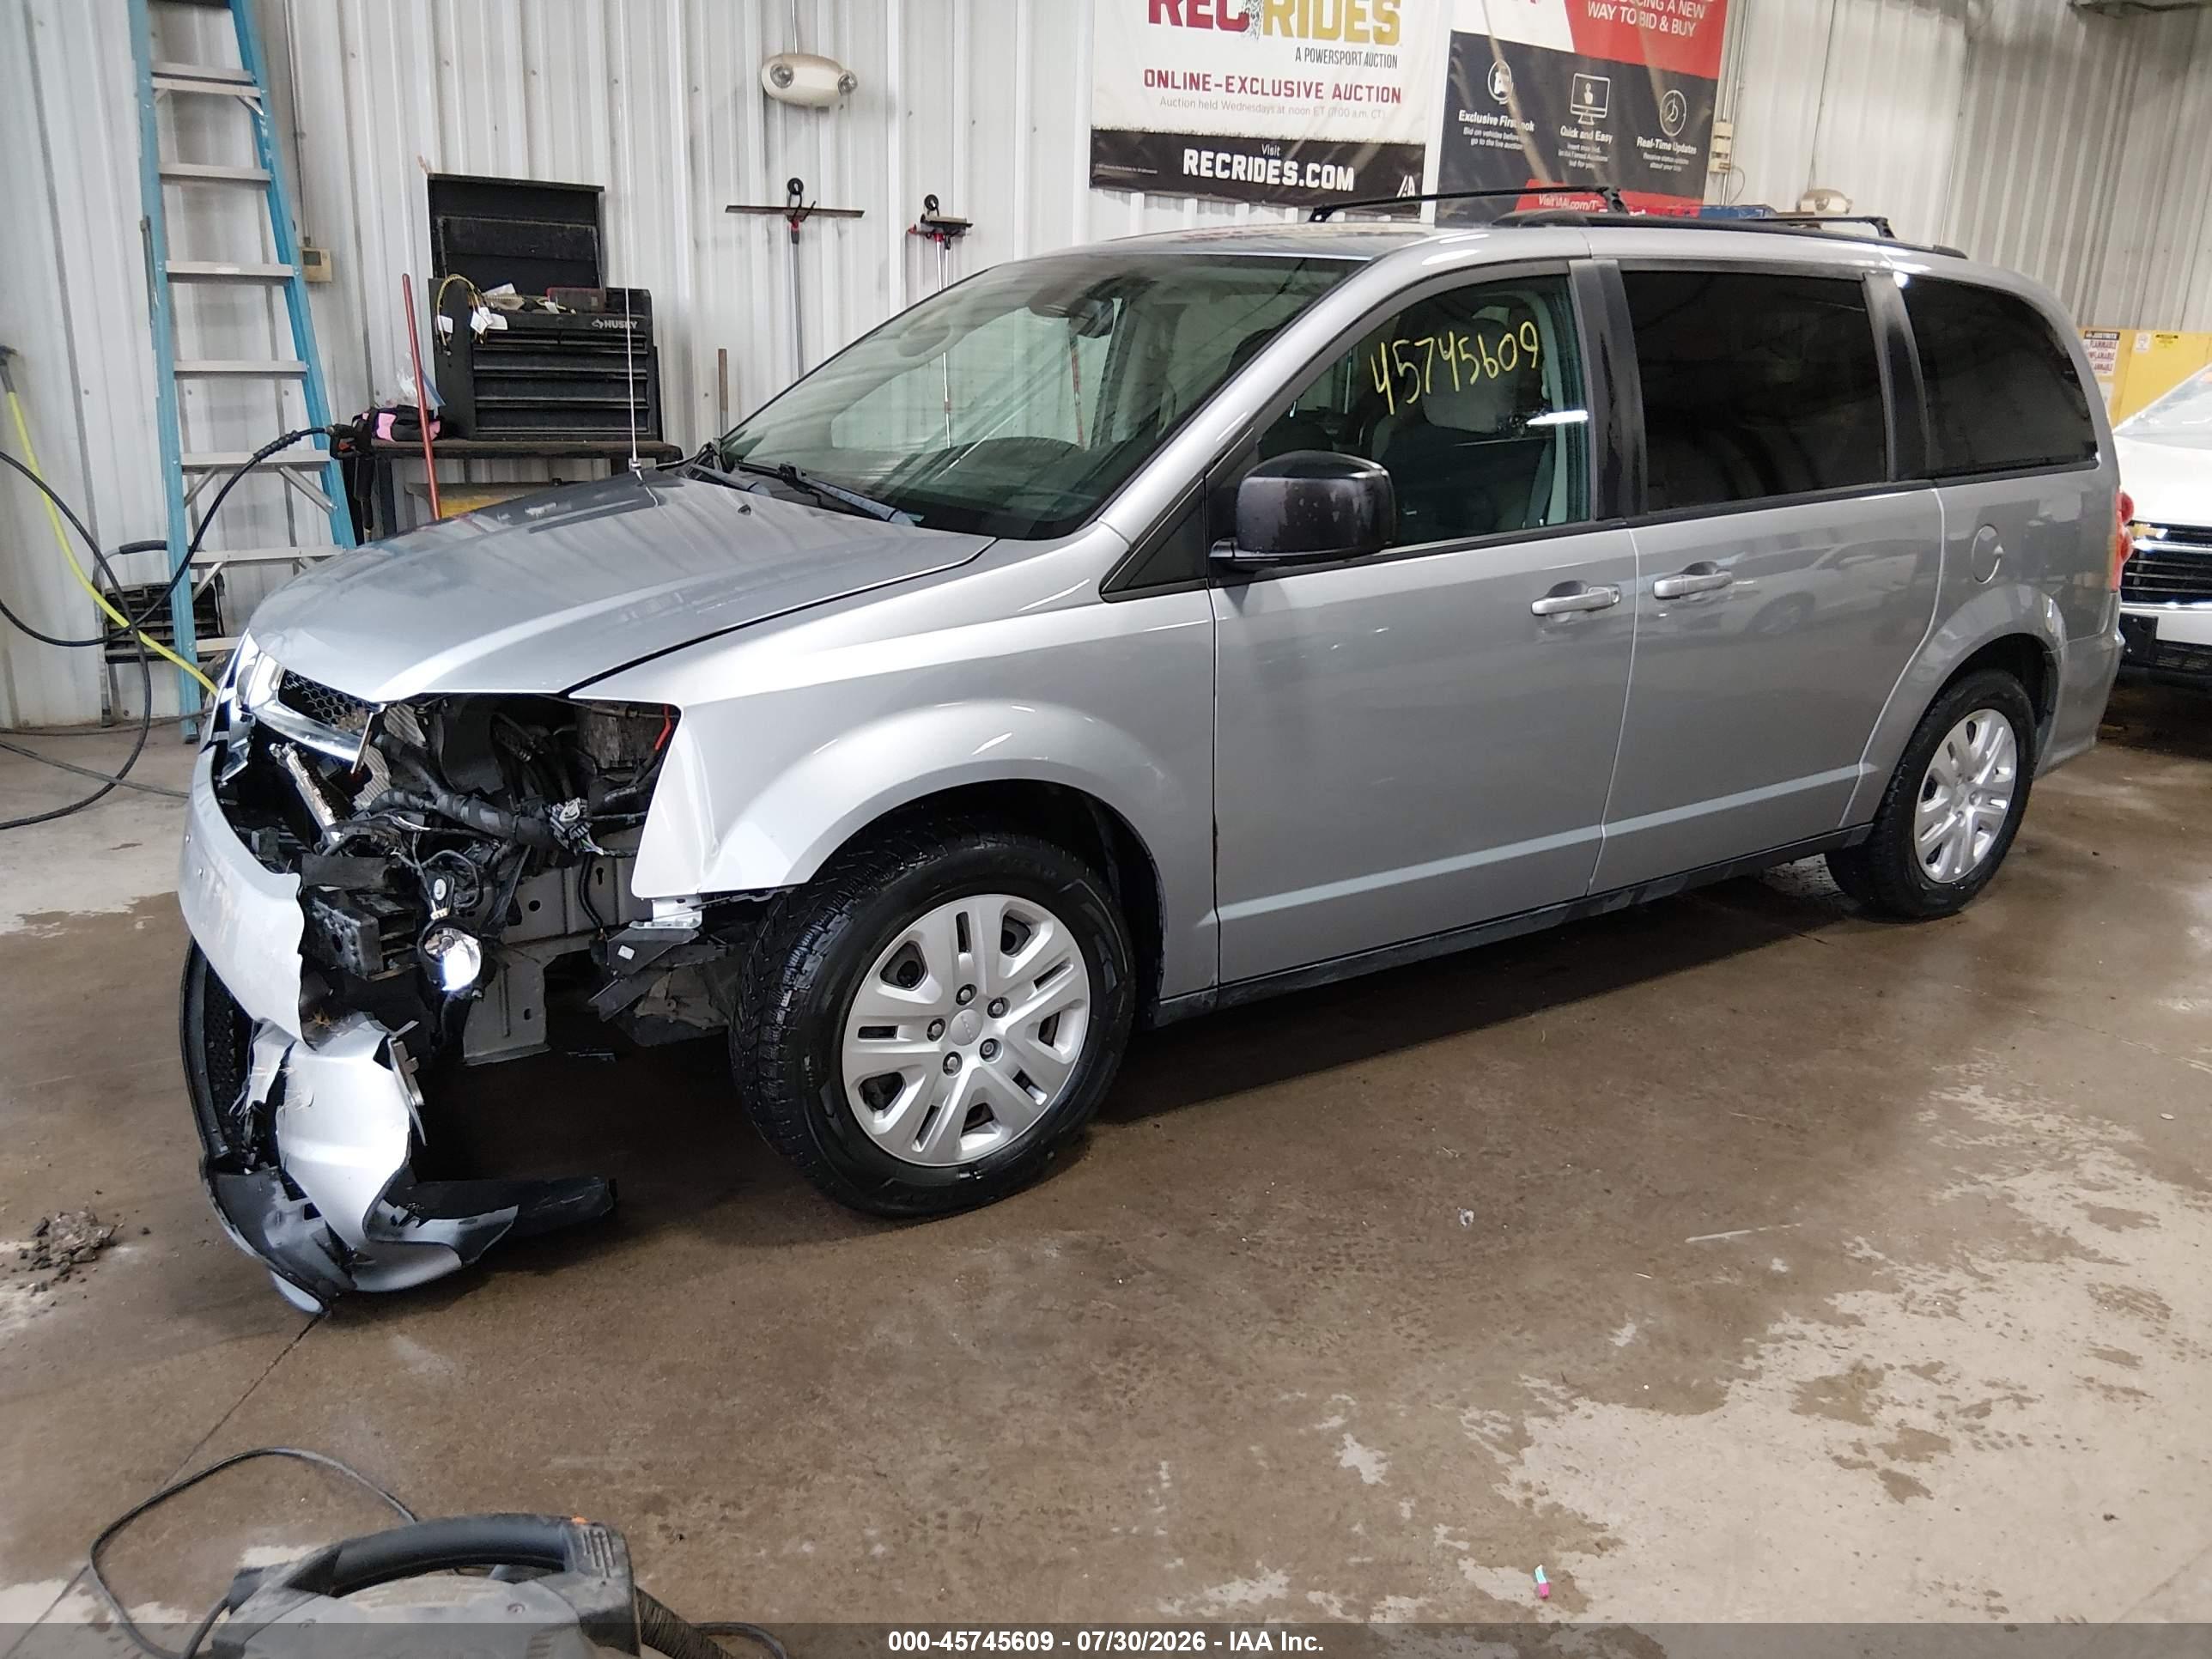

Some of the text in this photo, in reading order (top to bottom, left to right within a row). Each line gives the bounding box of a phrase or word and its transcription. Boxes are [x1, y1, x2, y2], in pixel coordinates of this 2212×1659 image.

[1588, 1, 1617, 21] WAY
[1620, 7, 1637, 25] TO
[1638, 11, 1657, 29] BID
[1659, 15, 1668, 33] &
[1671, 19, 1697, 37] BUY
[1667, 0, 1675, 14] A
[1678, 1, 1705, 19] NEW
[1262, 0, 1401, 46] RIDES
[1295, 46, 1398, 69] A POWERSPORT AUCTION
[1144, 69, 1401, 103] ONLINE-EXCLUSIVE AUCTION
[1160, 96, 1196, 109] Auction
[1198, 99, 1218, 110] held
[1221, 101, 1275, 114] Wednesdays
[1277, 106, 1285, 114] at
[1288, 106, 1310, 116] noon
[1459, 109, 1498, 126] Exclusive
[1560, 125, 1613, 144] Quick and Easy
[1261, 143, 1281, 157] Visit
[1637, 136, 1698, 155] Real-Time Updates
[1183, 149, 1355, 191] RECRIDES.COM
[604, 319, 638, 329] HUSKY
[1370, 321, 1539, 416] 45745609
